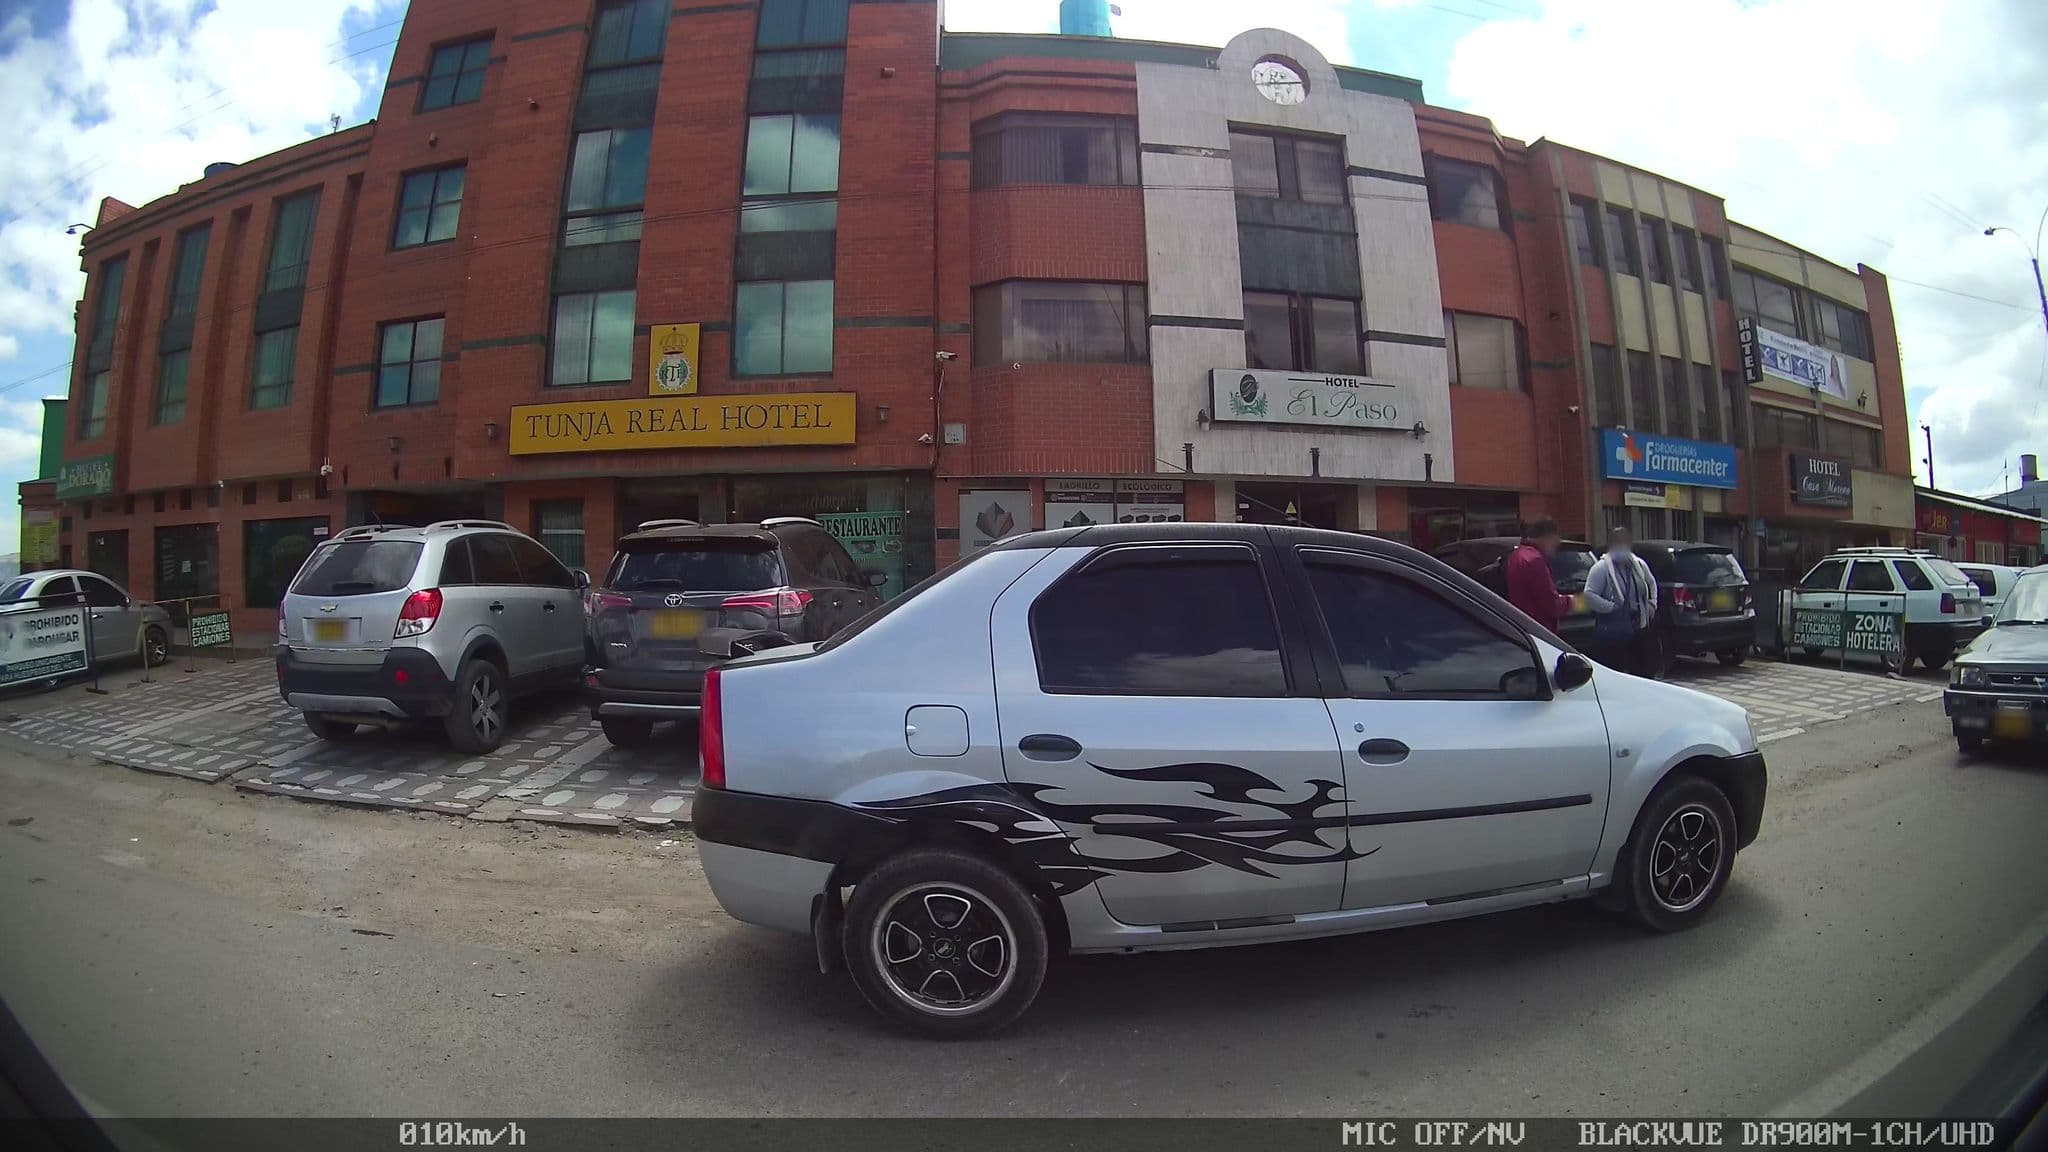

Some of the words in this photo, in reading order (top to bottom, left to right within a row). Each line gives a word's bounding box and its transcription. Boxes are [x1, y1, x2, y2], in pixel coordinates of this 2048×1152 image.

[1738, 317, 1756, 381] HOTEL
[1325, 377, 1359, 388] HOTEL
[1287, 388, 1317, 416] El
[1324, 391, 1397, 421] Paso
[526, 411, 614, 442] TUNJA
[626, 406, 708, 433] REAL
[720, 403, 832, 430] HOTEL
[1645, 441, 1728, 477] Farmacenter
[1809, 458, 1840, 476] HOTEL
[192, 613, 228, 627] PROHIBIDO
[1855, 614, 1894, 633] ZONA
[193, 631, 230, 647] CAMIONES
[1846, 631, 1900, 652] HOTELERA
